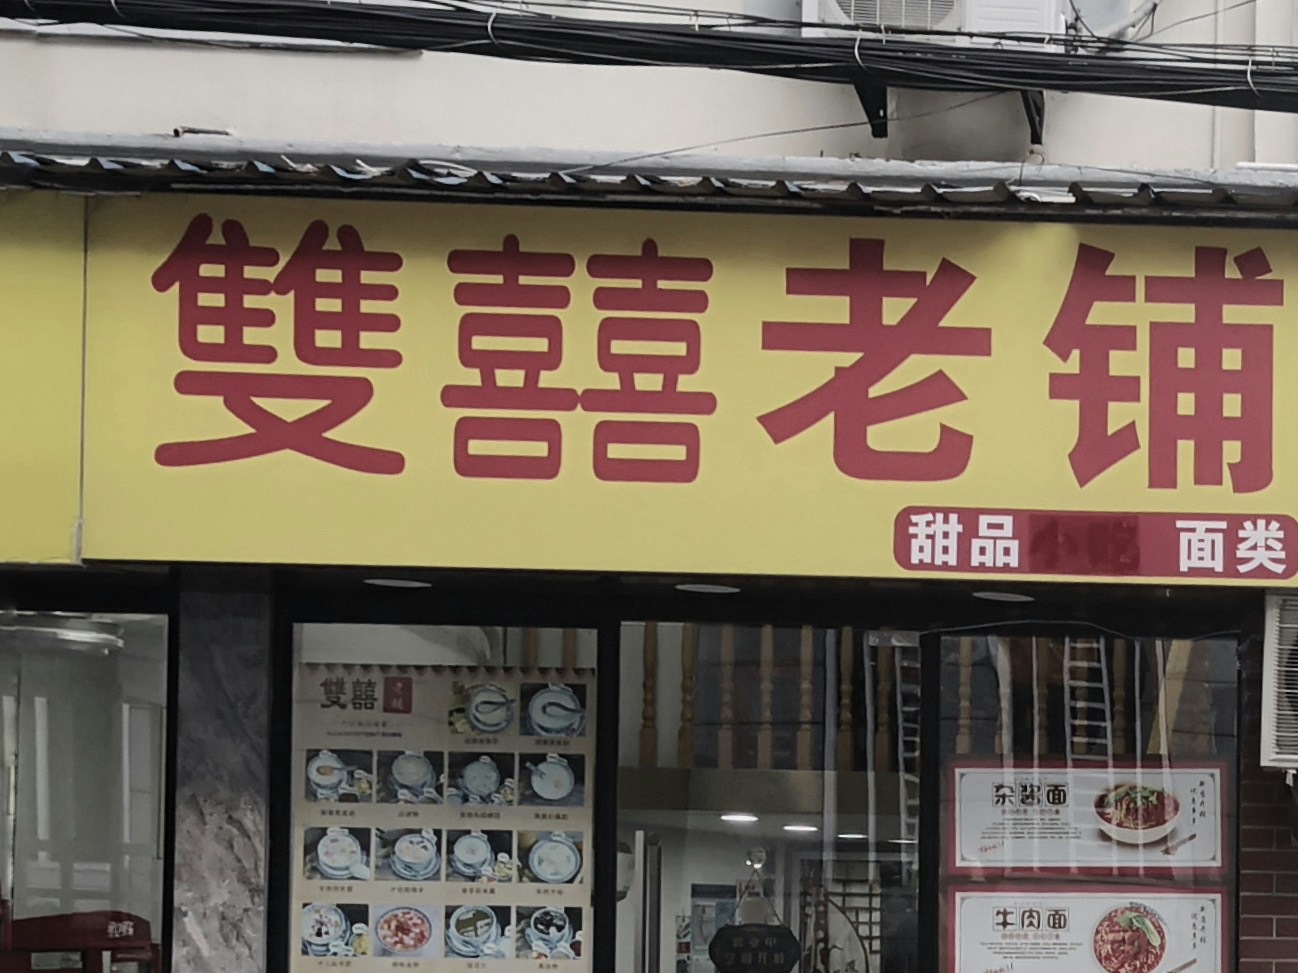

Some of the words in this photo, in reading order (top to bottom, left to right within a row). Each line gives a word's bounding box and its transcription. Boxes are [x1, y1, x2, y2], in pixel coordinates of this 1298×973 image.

[909, 513, 1019, 568] 甜品
[1175, 519, 1287, 573] 面类
[995, 908, 1067, 930] 牛肉面
